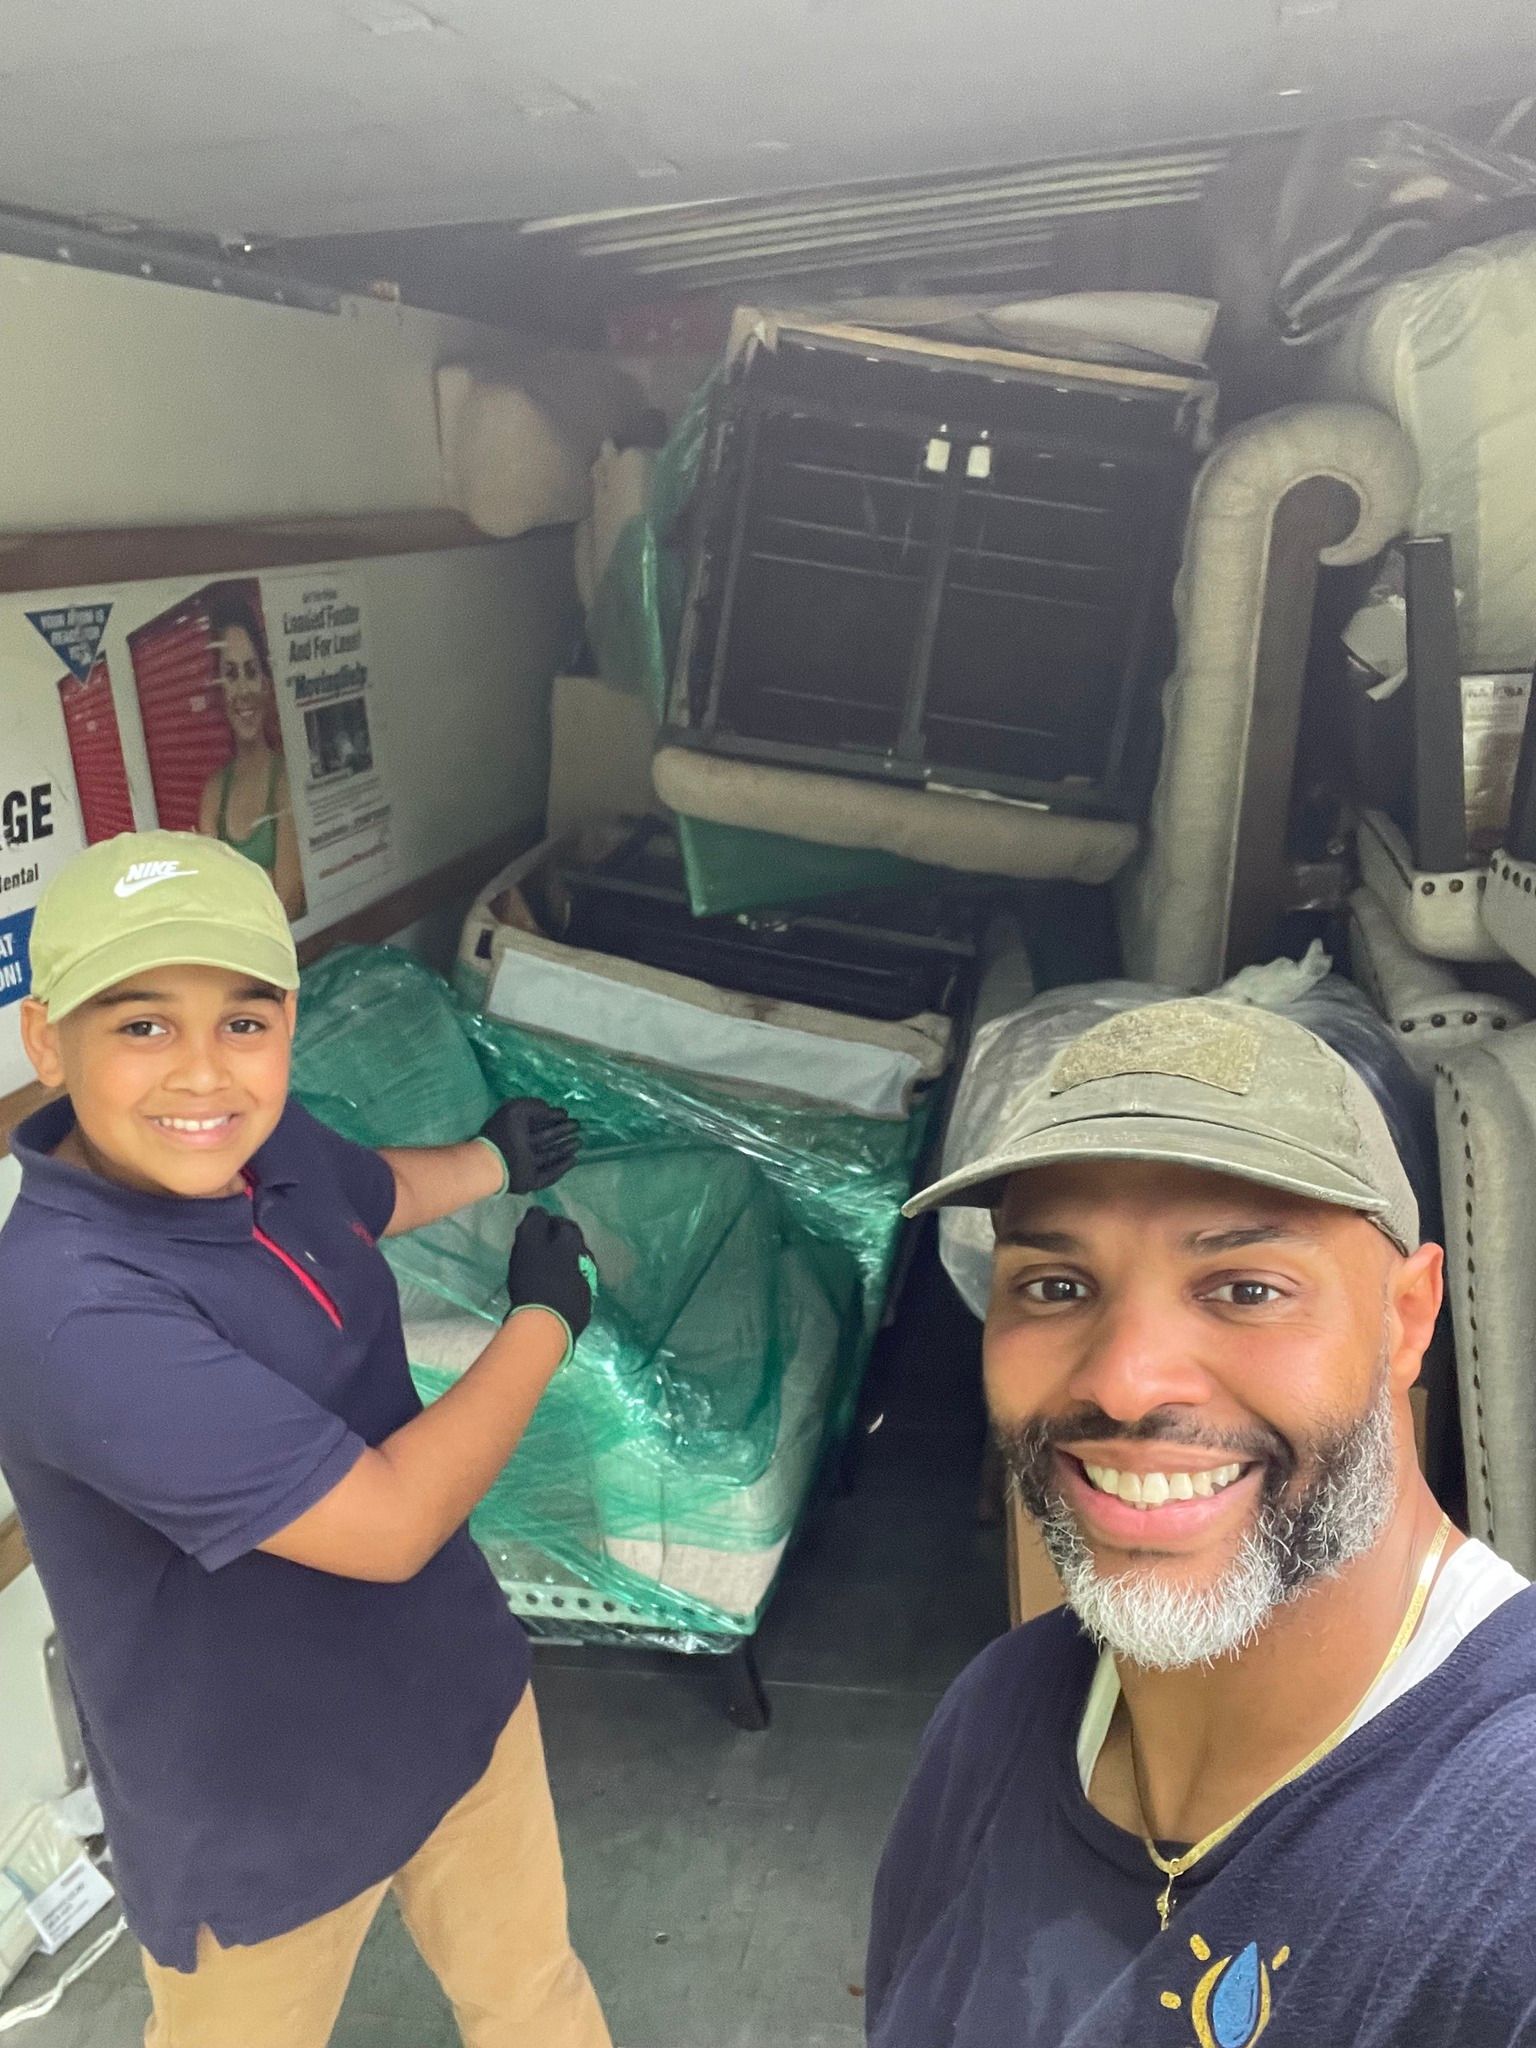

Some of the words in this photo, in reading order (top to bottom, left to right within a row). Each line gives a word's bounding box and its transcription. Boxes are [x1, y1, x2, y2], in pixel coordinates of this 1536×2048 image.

[314, 635, 332, 659] For
[0, 863, 39, 894] ental
[125, 860, 181, 883] NIKE
